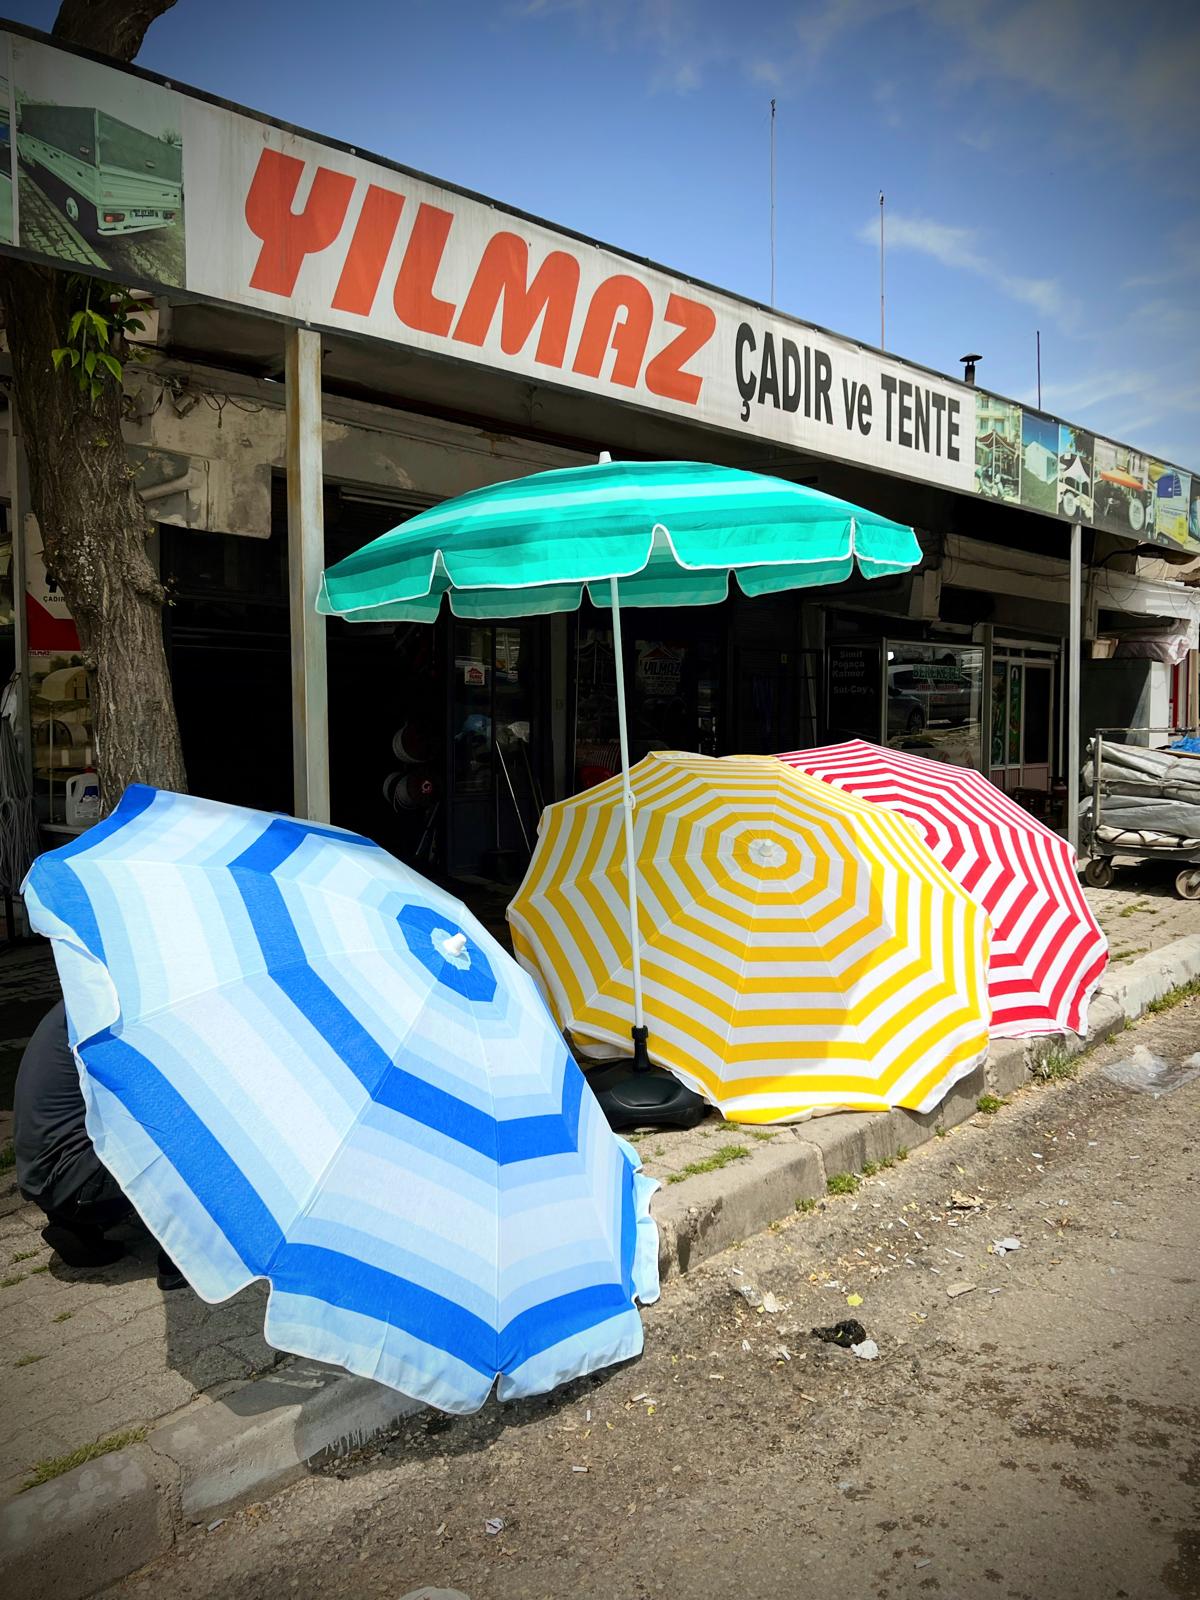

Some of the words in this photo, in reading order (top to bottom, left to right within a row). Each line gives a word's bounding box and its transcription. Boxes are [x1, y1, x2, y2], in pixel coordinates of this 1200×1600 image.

[245, 148, 716, 405] YILMAZ
[735, 322, 833, 422] ÇADIR
[842, 377, 872, 436] ve
[881, 373, 960, 462] TENTE
